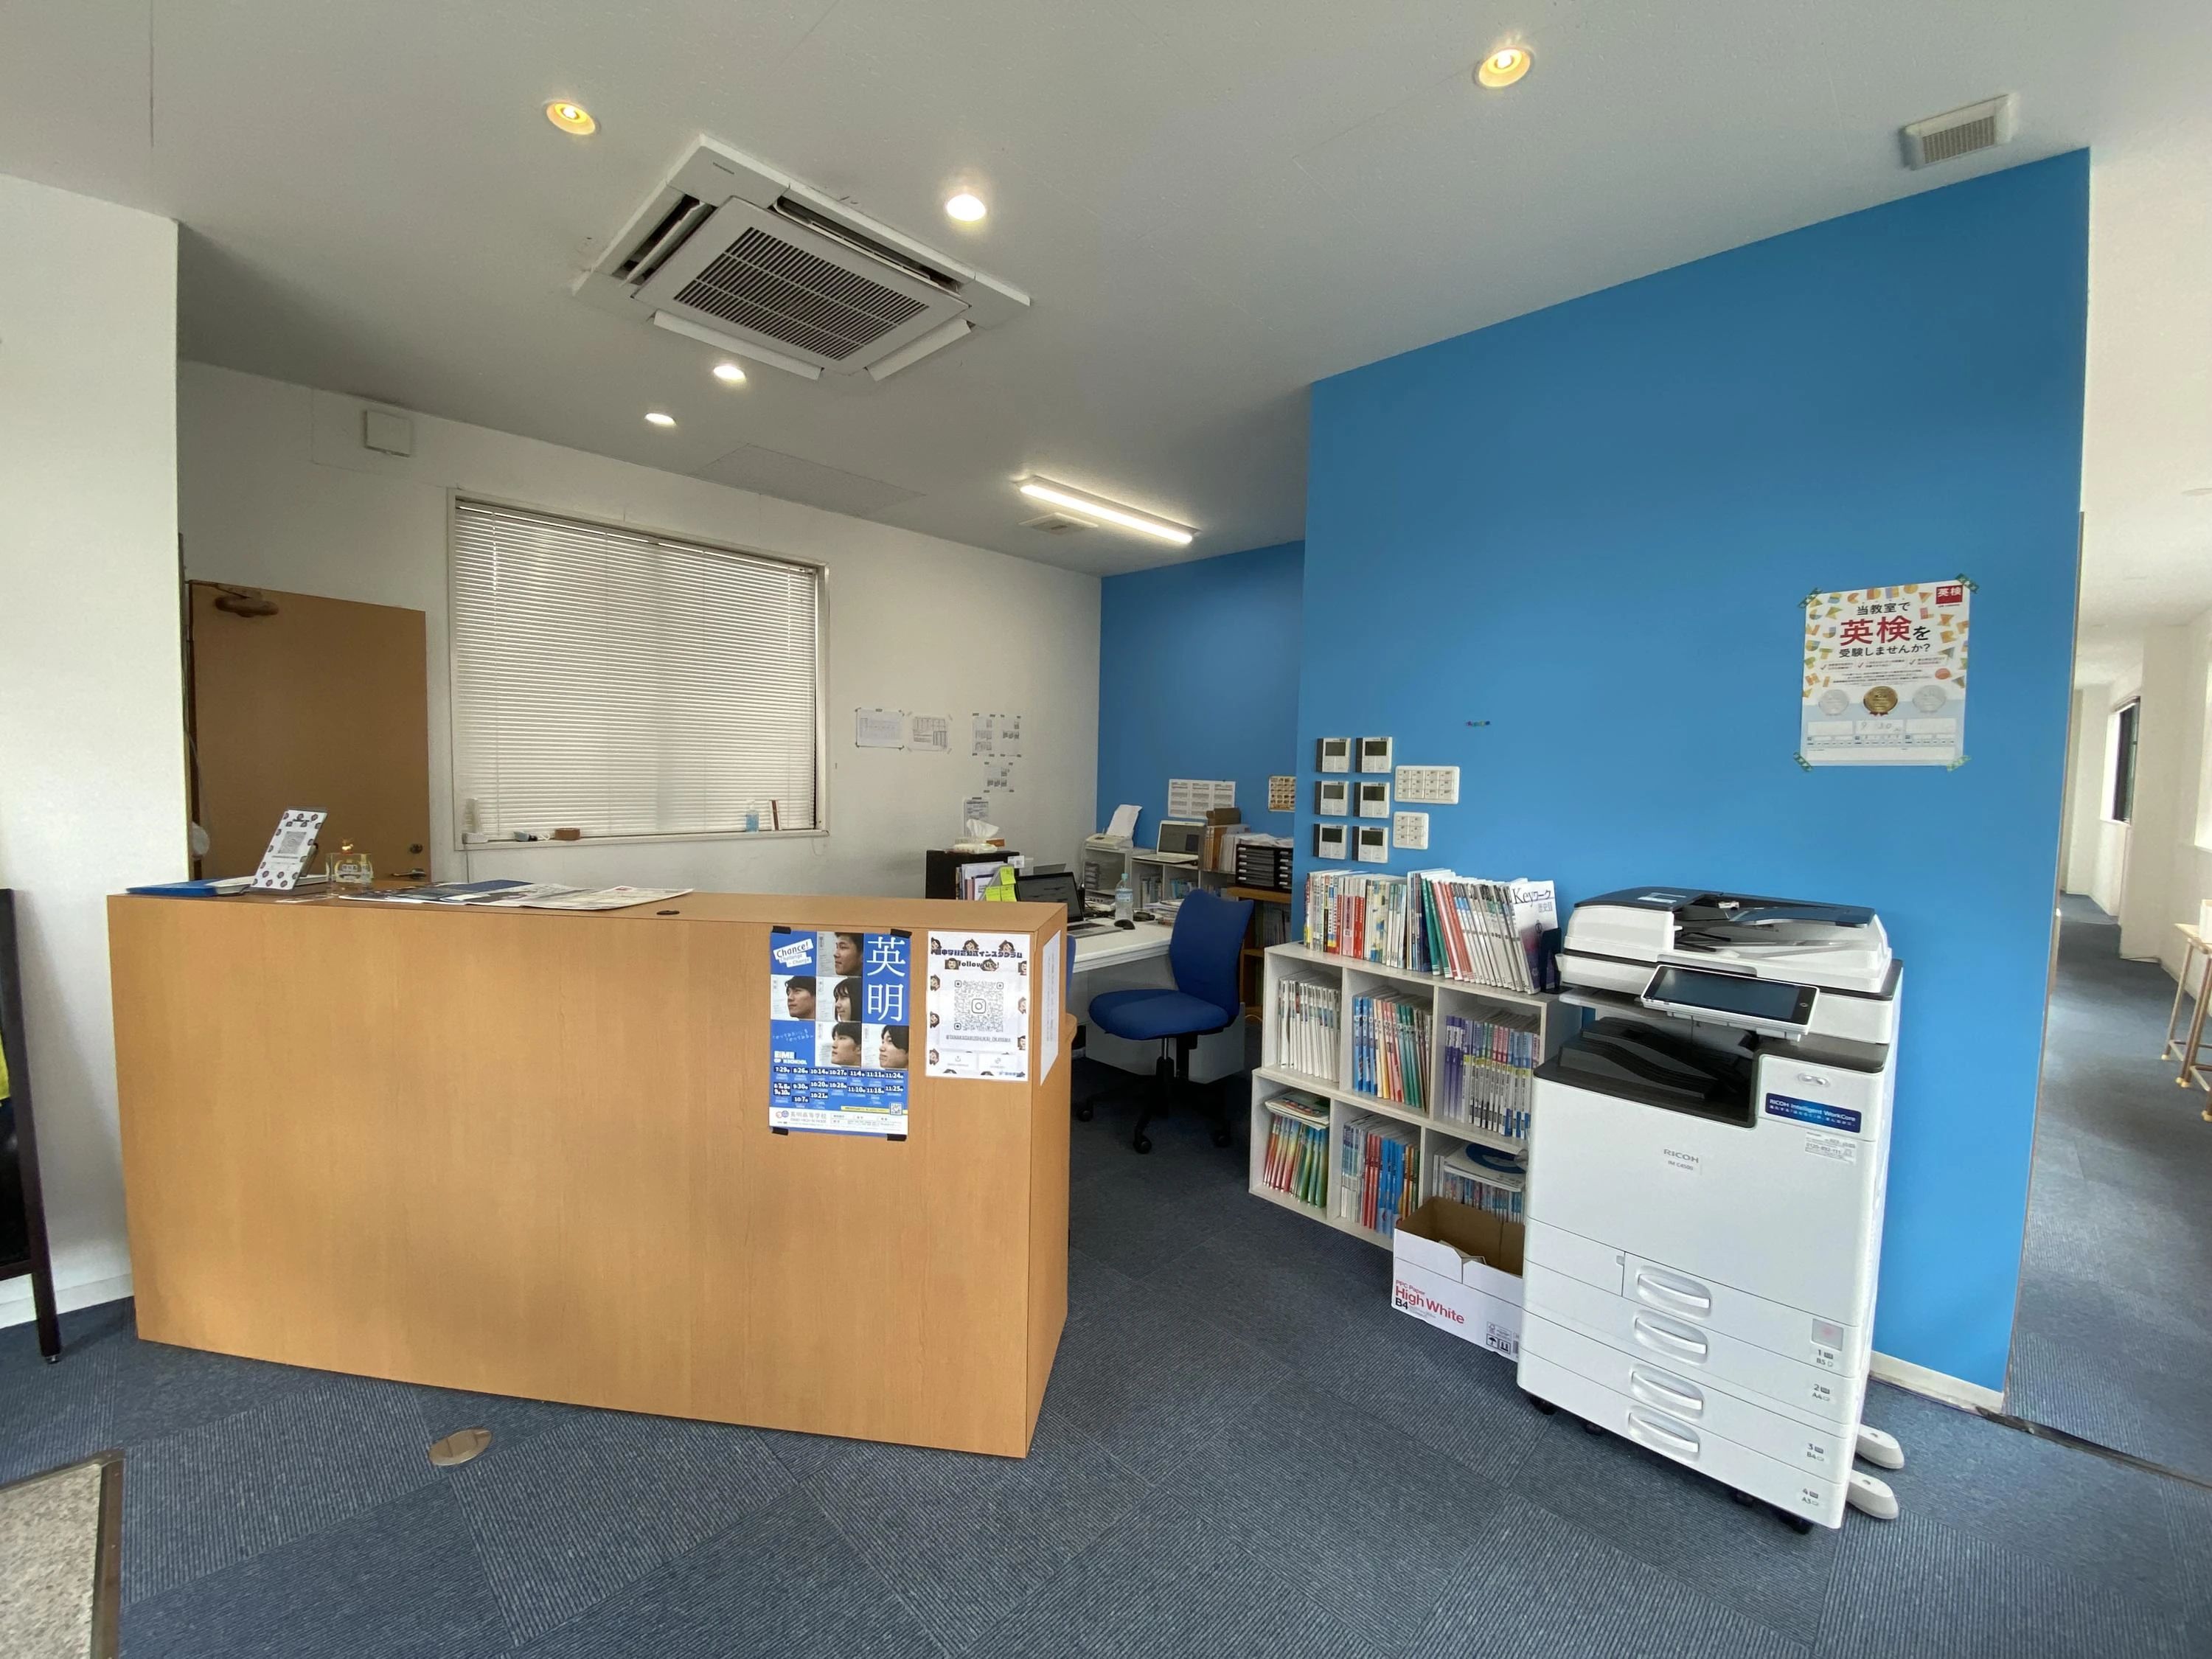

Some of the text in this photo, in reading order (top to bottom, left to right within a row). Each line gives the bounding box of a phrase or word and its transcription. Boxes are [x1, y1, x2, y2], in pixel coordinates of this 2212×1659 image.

[1936, 587, 1962, 597] 英検
[1857, 601, 1910, 616] 当教室で
[1840, 615, 1931, 647] 英検を
[1512, 887, 1551, 907] Keyワーク
[776, 941, 809, 958] Chance!
[866, 936, 905, 1023] 英明
[1770, 1099, 1789, 1107] RICOH
[1663, 1148, 1700, 1164] RICOH
[1396, 1279, 1426, 1295] PPC Paper
[1395, 1297, 1408, 1310] B4
[1395, 1286, 1424, 1307] High
[1426, 1298, 1465, 1324] White
